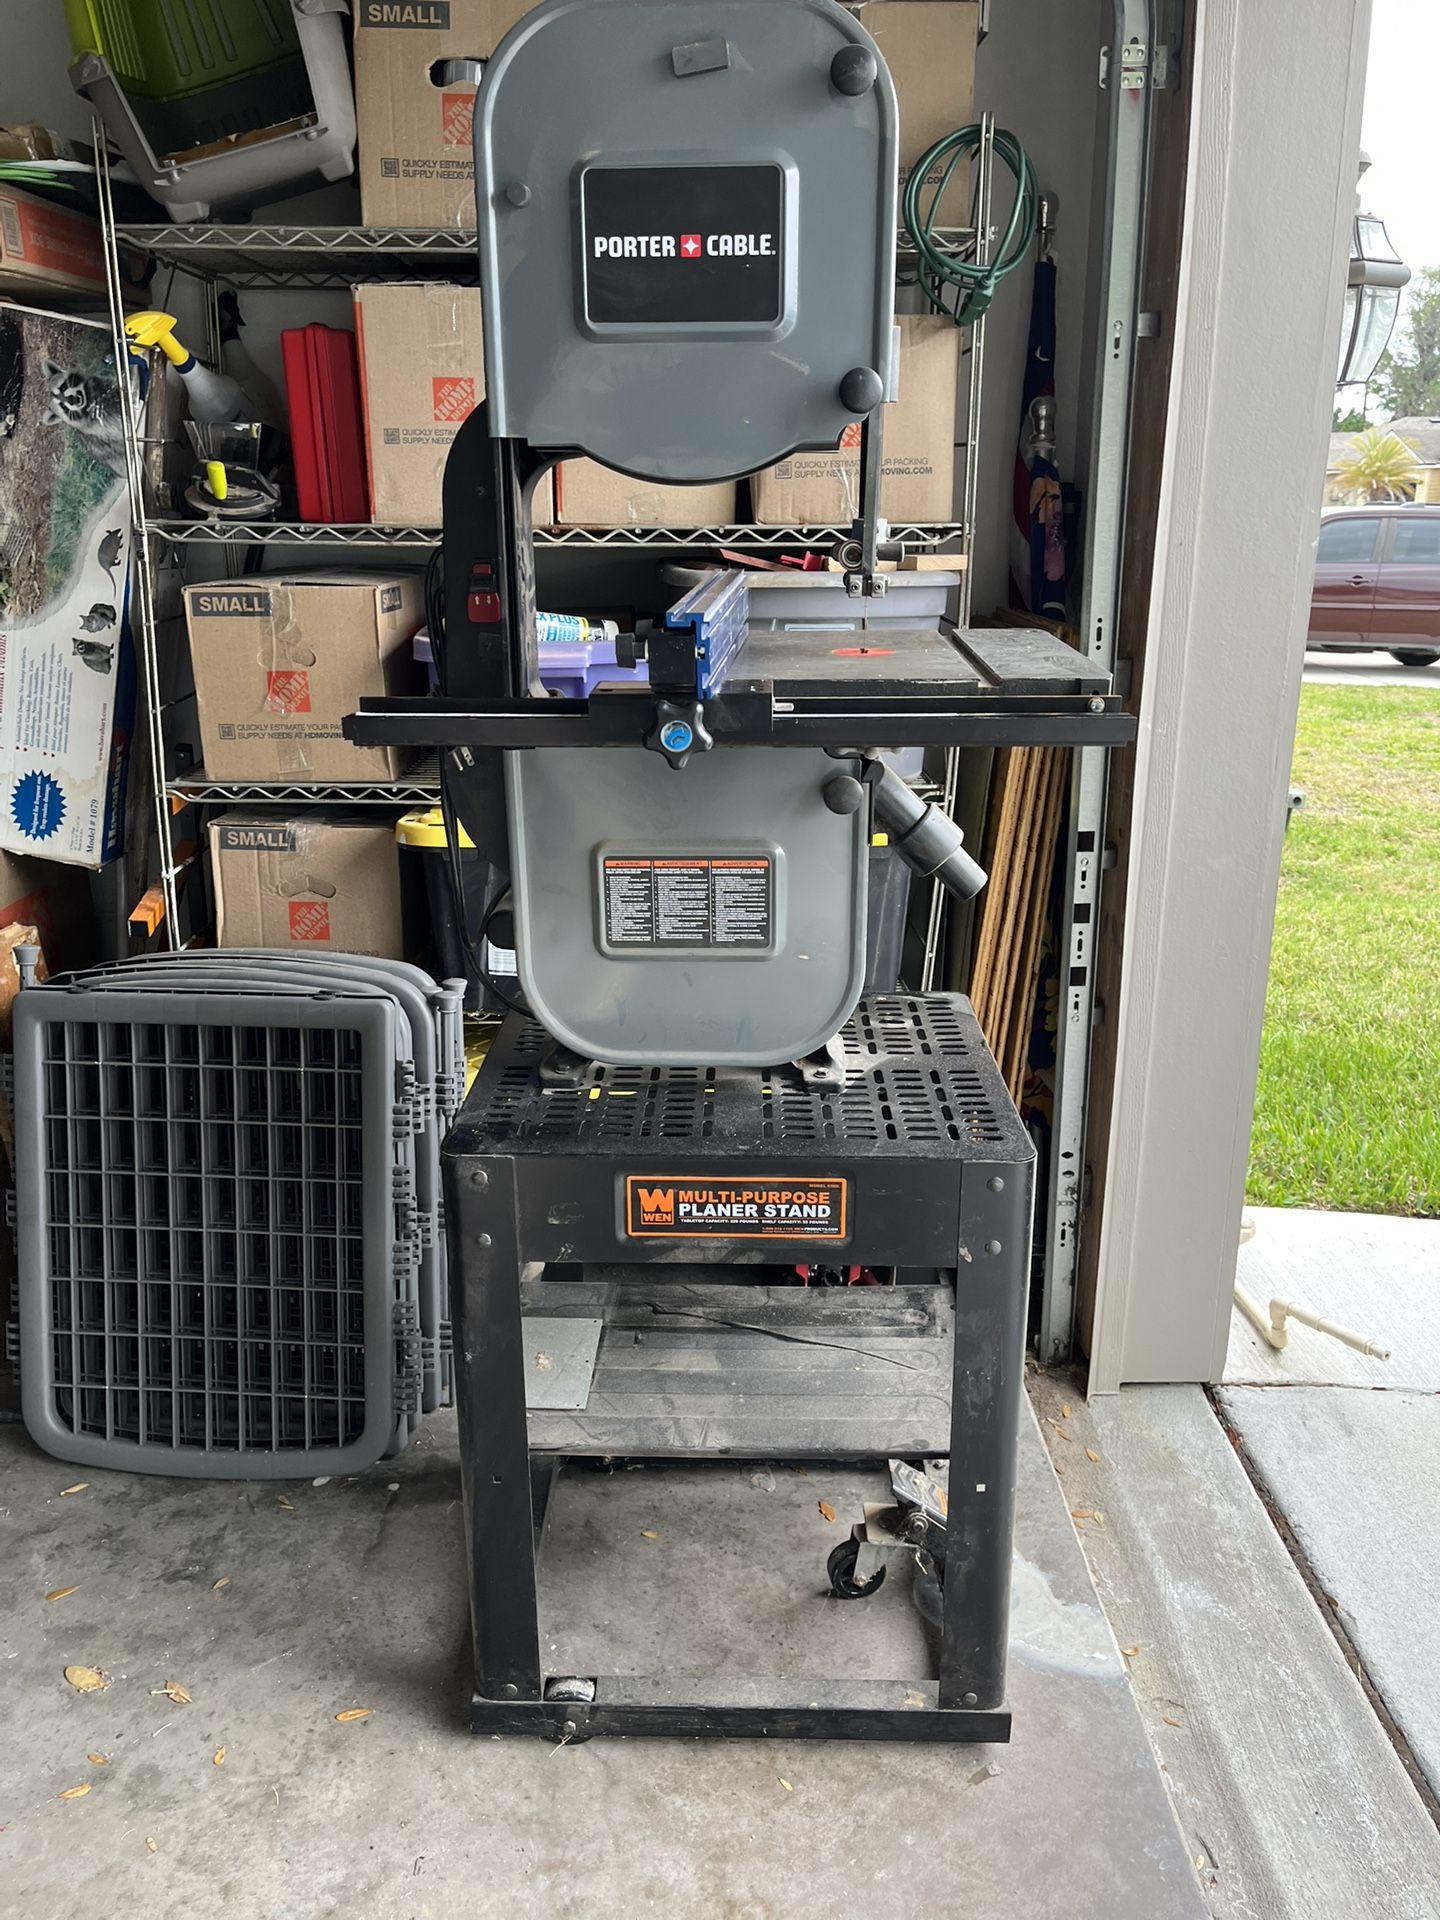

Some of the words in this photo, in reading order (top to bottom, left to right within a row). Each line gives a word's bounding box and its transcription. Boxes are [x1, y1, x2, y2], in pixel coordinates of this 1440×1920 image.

[368, 4, 442, 24] SMALL
[401, 159, 437, 169] QUICKLY
[440, 160, 475, 170] ESTIMAT
[401, 169, 434, 178] SUPPLY
[436, 171, 464, 179] NEEDS
[594, 235, 676, 258] PORTER
[401, 428, 432, 436] QUICKLY
[434, 428, 458, 437] ESTIM
[401, 437, 431, 445] SUPPLY
[794, 460, 828, 470] QUICKLY
[893, 457, 928, 466] PACKING
[794, 469, 825, 478] SUPPLY
[199, 596, 265, 613] SMALL
[548, 614, 580, 626] PLUS
[97, 702, 107, 762] www.havahart.com
[236, 723, 268, 732] QUICKLY
[270, 723, 305, 731] ESTIMATE
[307, 723, 328, 731] YOUR
[237, 731, 266, 740] SUPPLY
[268, 731, 292, 740] NEEDS
[294, 731, 302, 739] AT
[304, 731, 342, 739] HDMOVIN
[90, 798, 99, 819] 1079
[86, 827, 97, 855] Model
[227, 831, 288, 847] SMALL
[679, 1190, 830, 1205] MULTI-PURPOSE
[679, 1203, 758, 1218] PLANER
[764, 1204, 831, 1218] STAND
[643, 1213, 672, 1223] WEN
